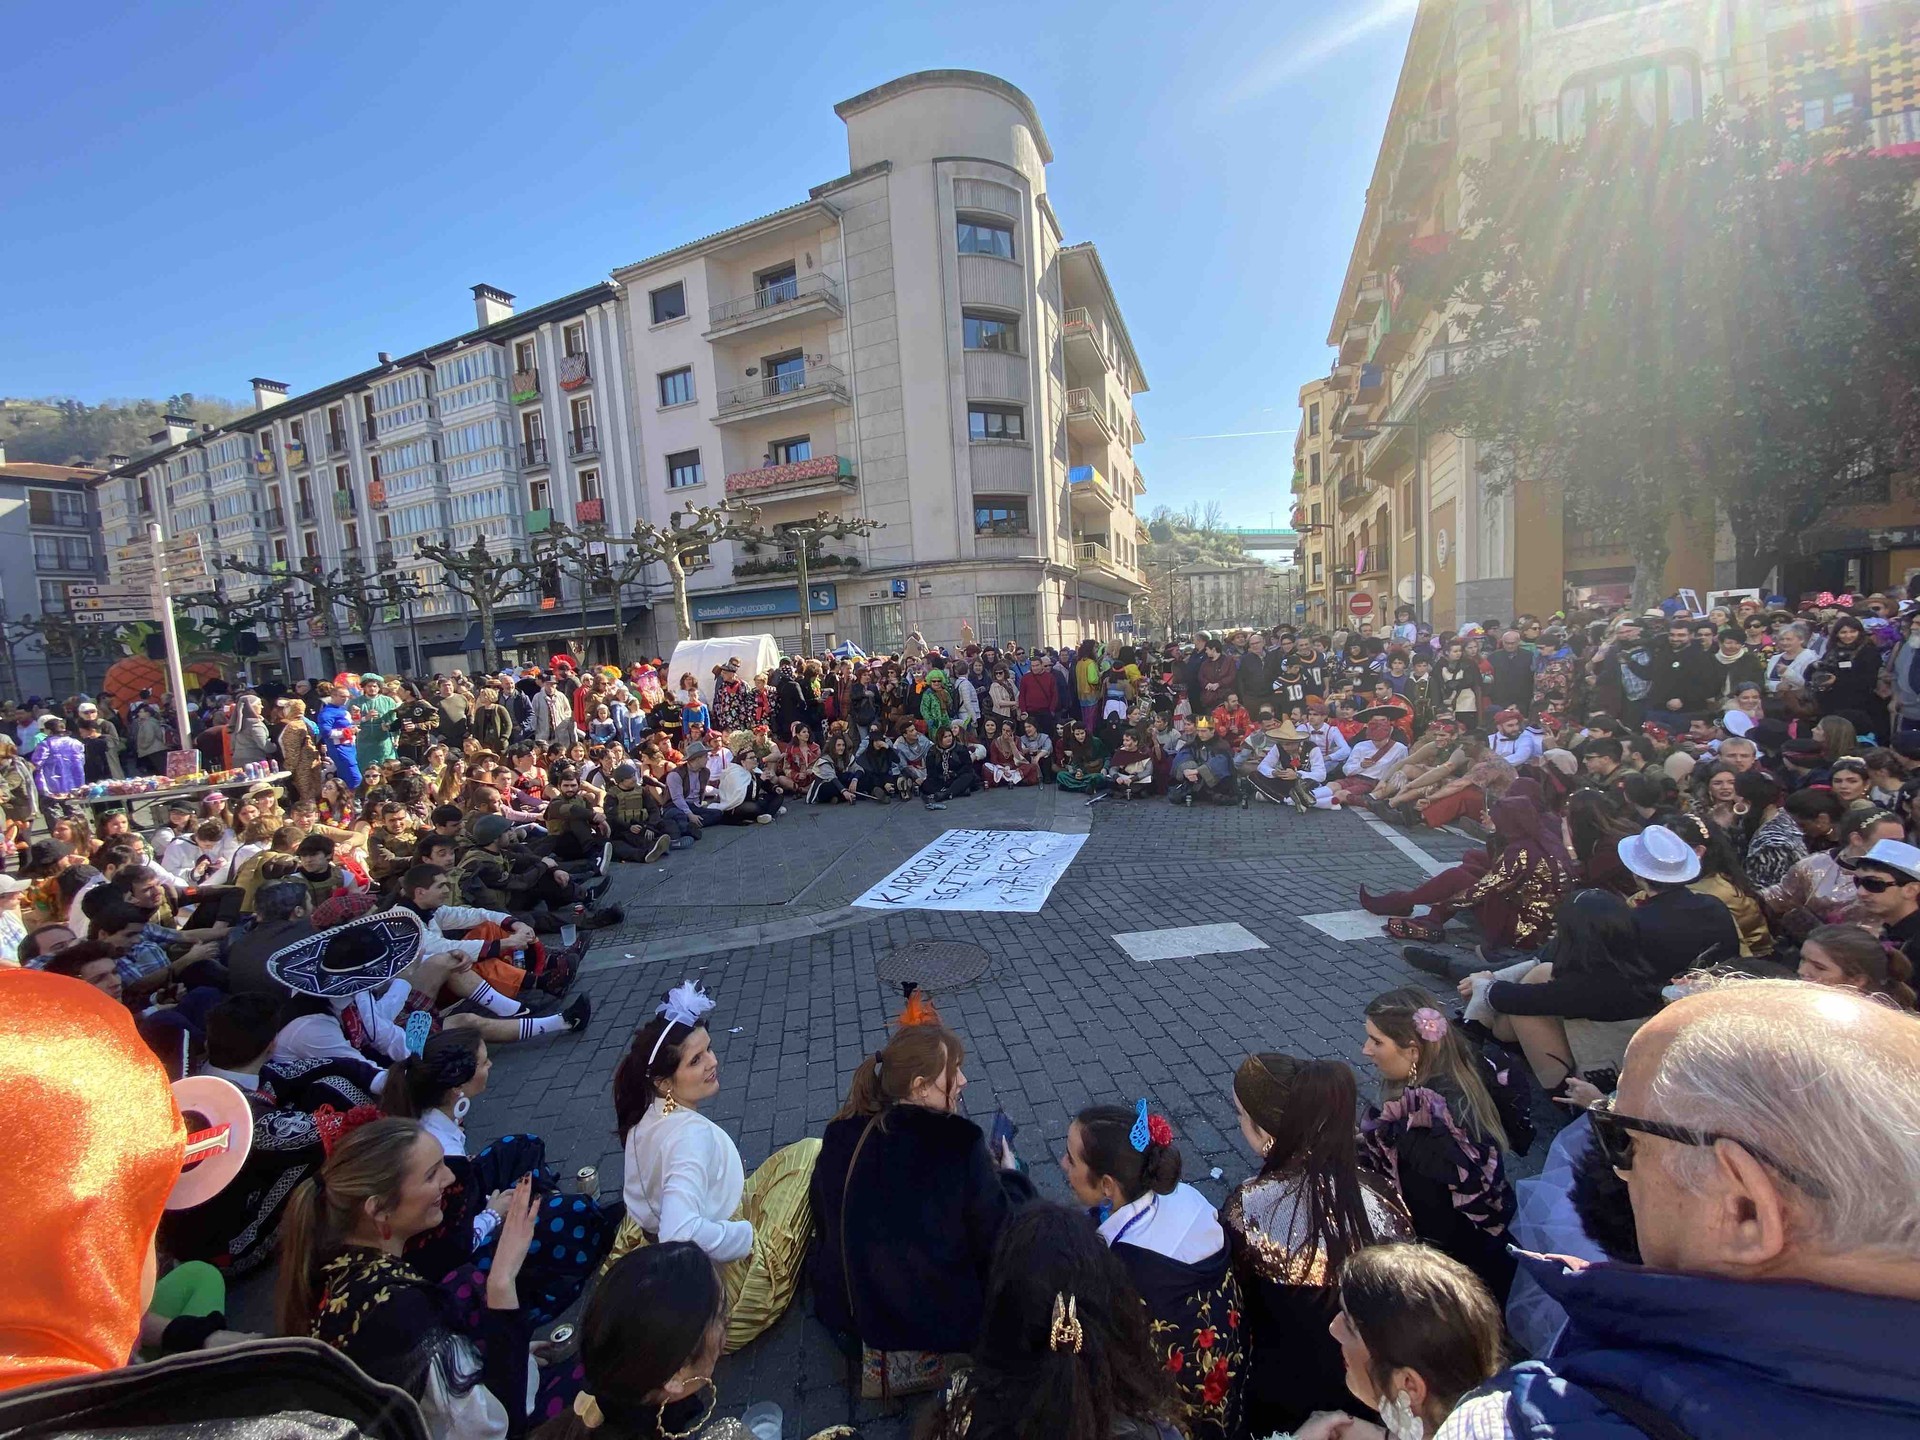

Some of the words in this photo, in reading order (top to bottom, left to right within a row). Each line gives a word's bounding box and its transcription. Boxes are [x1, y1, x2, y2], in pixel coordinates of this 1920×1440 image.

[1287, 684, 1303, 701] 10
[870, 848, 952, 904] KARROZAK
[925, 851, 991, 901] EGITEKO
